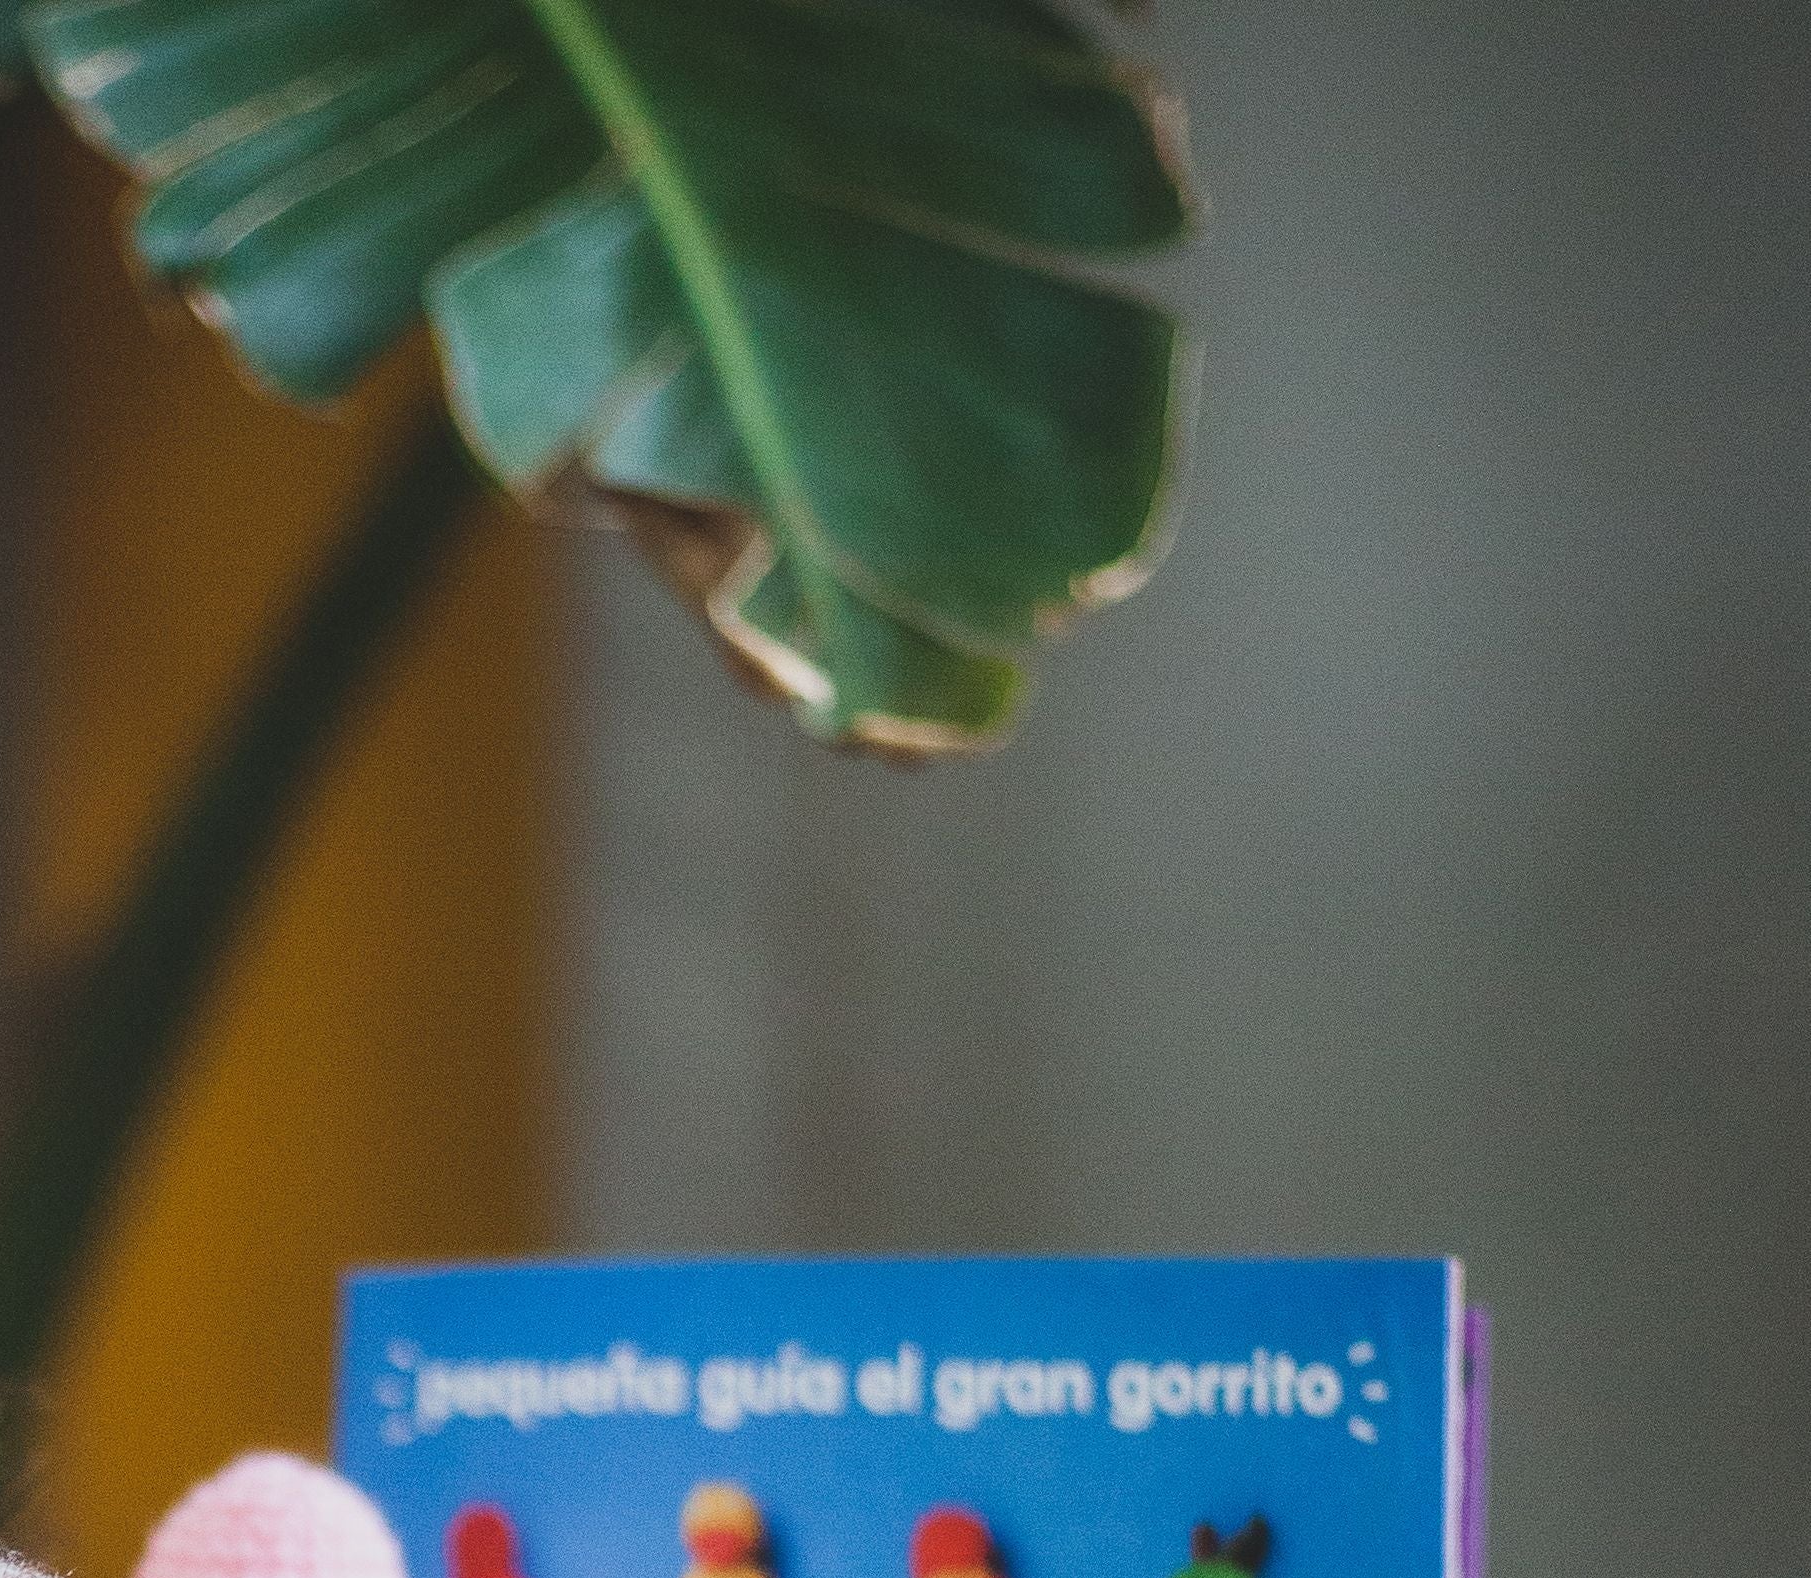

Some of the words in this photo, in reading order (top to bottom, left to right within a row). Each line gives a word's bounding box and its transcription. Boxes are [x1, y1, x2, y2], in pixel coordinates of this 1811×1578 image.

[856, 1341, 923, 1415] el
[934, 1358, 1094, 1432] gran
[1108, 1346, 1342, 1432] gorrito
